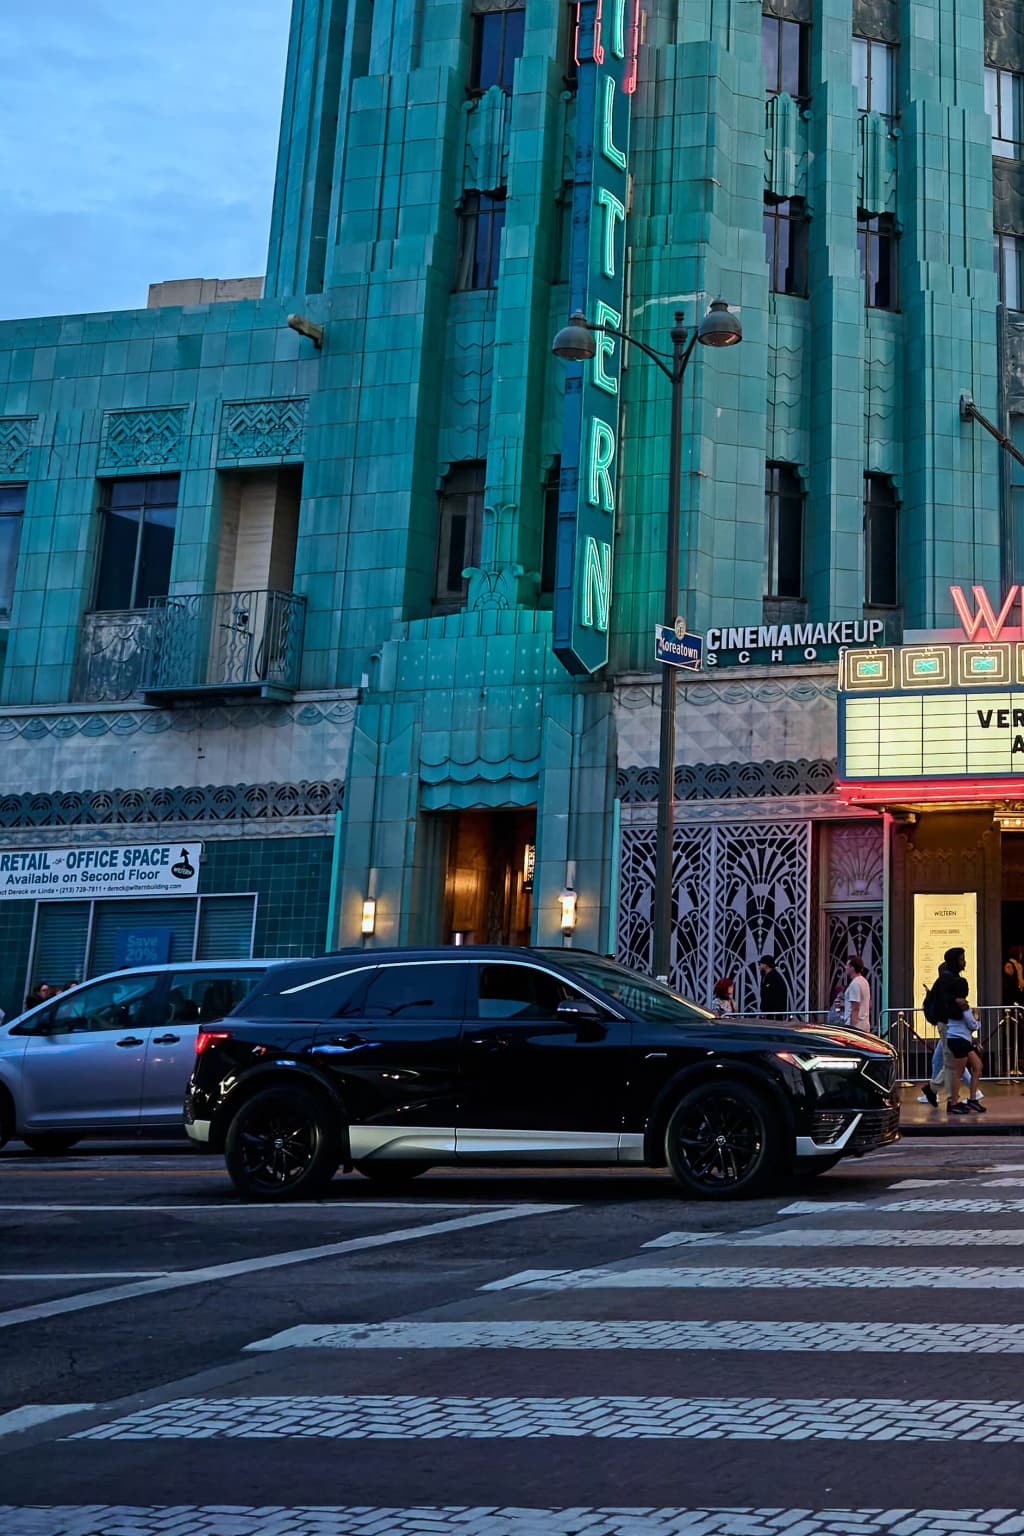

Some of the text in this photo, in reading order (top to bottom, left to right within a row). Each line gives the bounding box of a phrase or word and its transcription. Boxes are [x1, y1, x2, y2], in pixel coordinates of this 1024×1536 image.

[659, 637, 698, 660] Koreatown
[1, 853, 50, 871] RETAIL
[66, 850, 119, 869] OFFICE
[123, 848, 170, 866] SPACE
[6, 869, 160, 885] Available on Second Floor
[127, 935, 158, 946] Save
[125, 947, 158, 961] 20%
